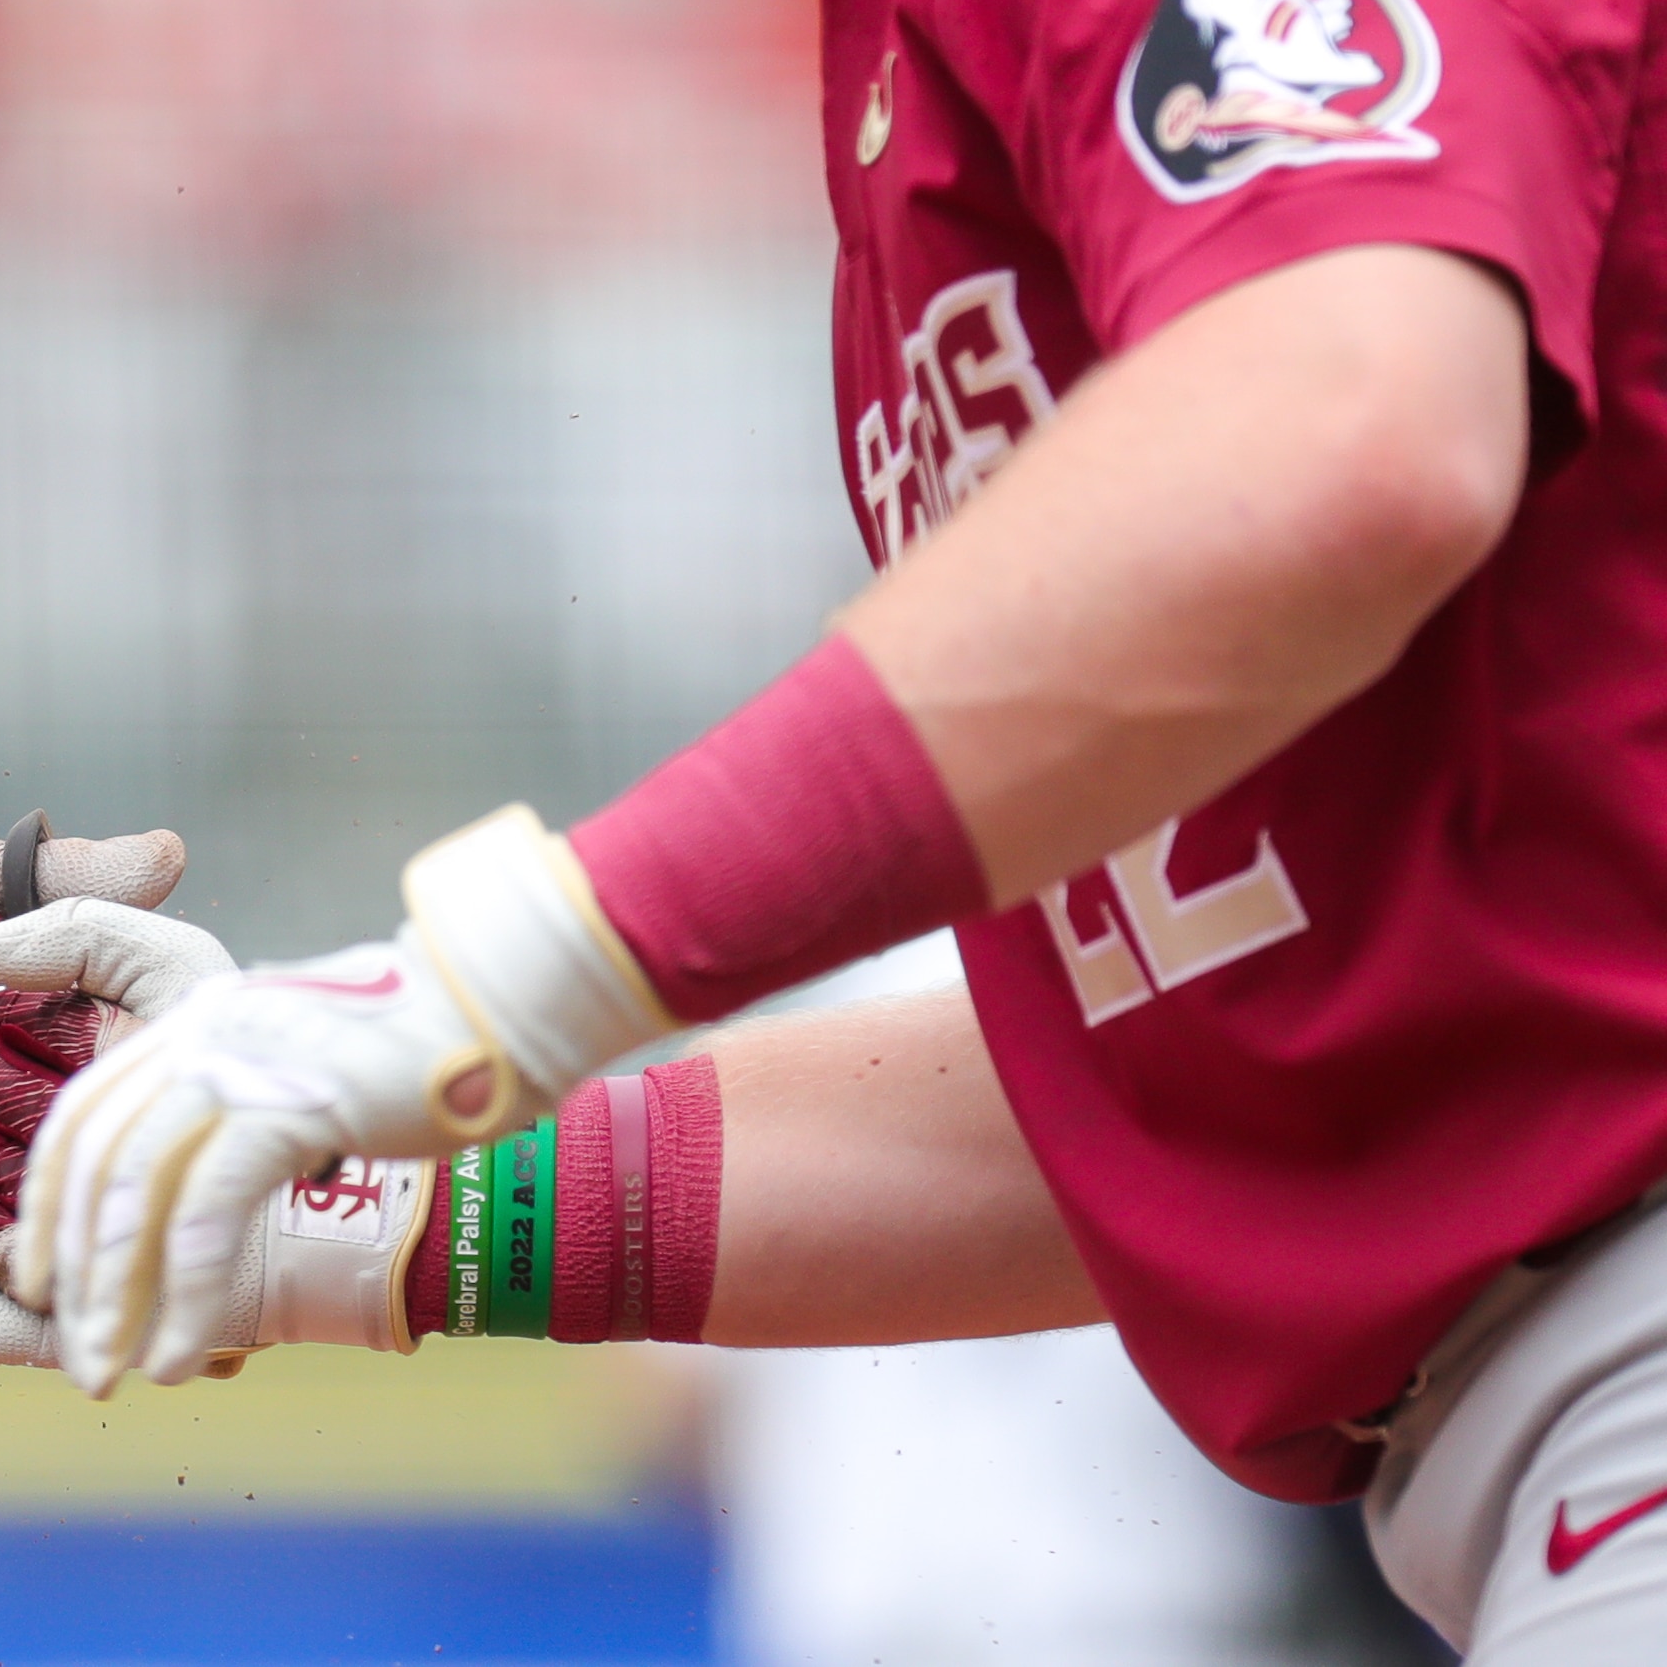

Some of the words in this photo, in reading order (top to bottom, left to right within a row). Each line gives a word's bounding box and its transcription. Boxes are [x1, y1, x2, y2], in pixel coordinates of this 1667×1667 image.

[512, 1138, 538, 1210] ACC
[456, 1186, 486, 1256] Palsy
[509, 1217, 535, 1294] 2022
[452, 1263, 480, 1335] Cerebral
